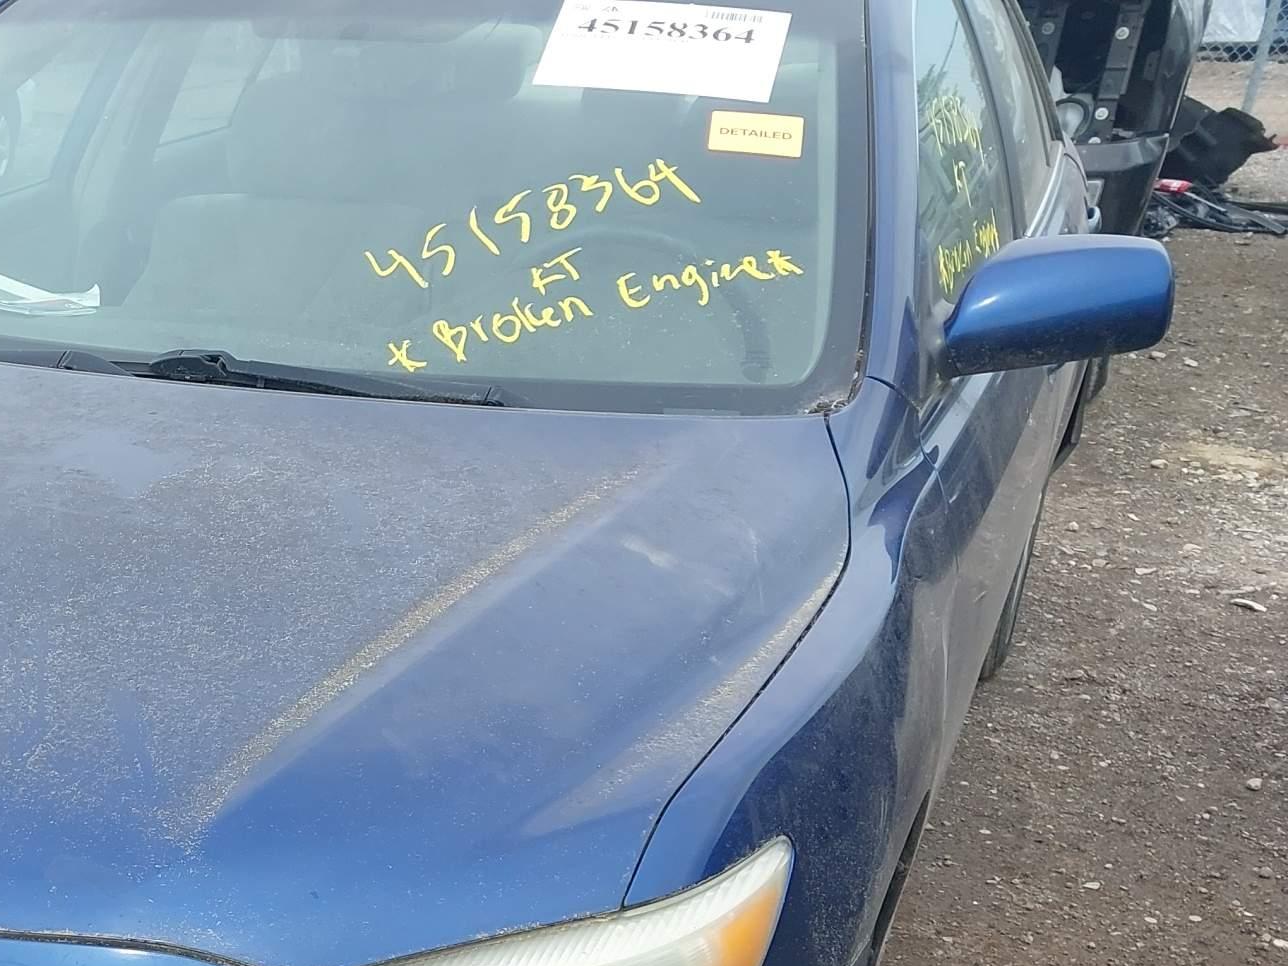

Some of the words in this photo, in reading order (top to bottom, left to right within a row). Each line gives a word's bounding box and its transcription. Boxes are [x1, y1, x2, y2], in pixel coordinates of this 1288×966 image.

[577, 17, 755, 44] 45158364
[719, 127, 793, 140] DETAILED
[364, 158, 702, 288] 45158364
[432, 294, 594, 363] Broken
